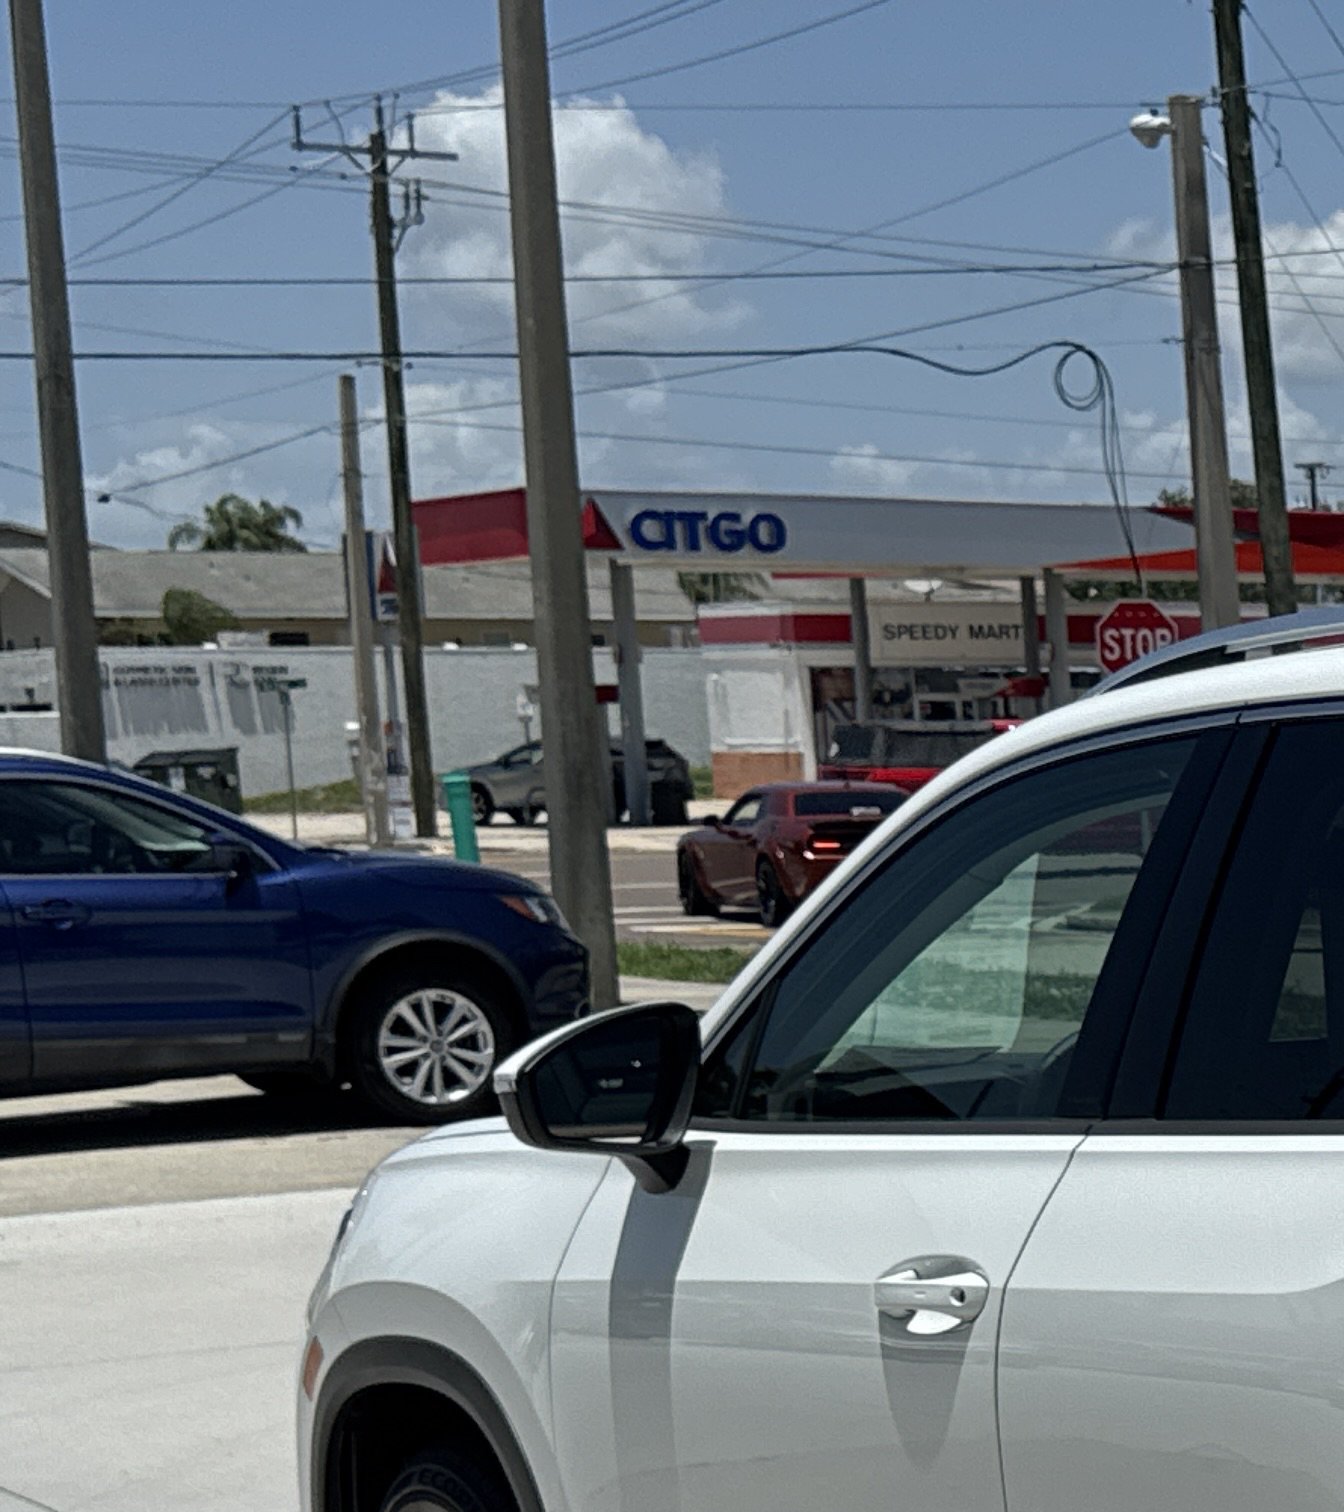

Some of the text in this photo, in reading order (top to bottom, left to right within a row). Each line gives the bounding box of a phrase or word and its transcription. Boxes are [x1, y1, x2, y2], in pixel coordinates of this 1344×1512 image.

[630, 508, 788, 554] CITGO
[882, 623, 1024, 641] SPEEDY MART
[1102, 627, 1173, 661] STOP
